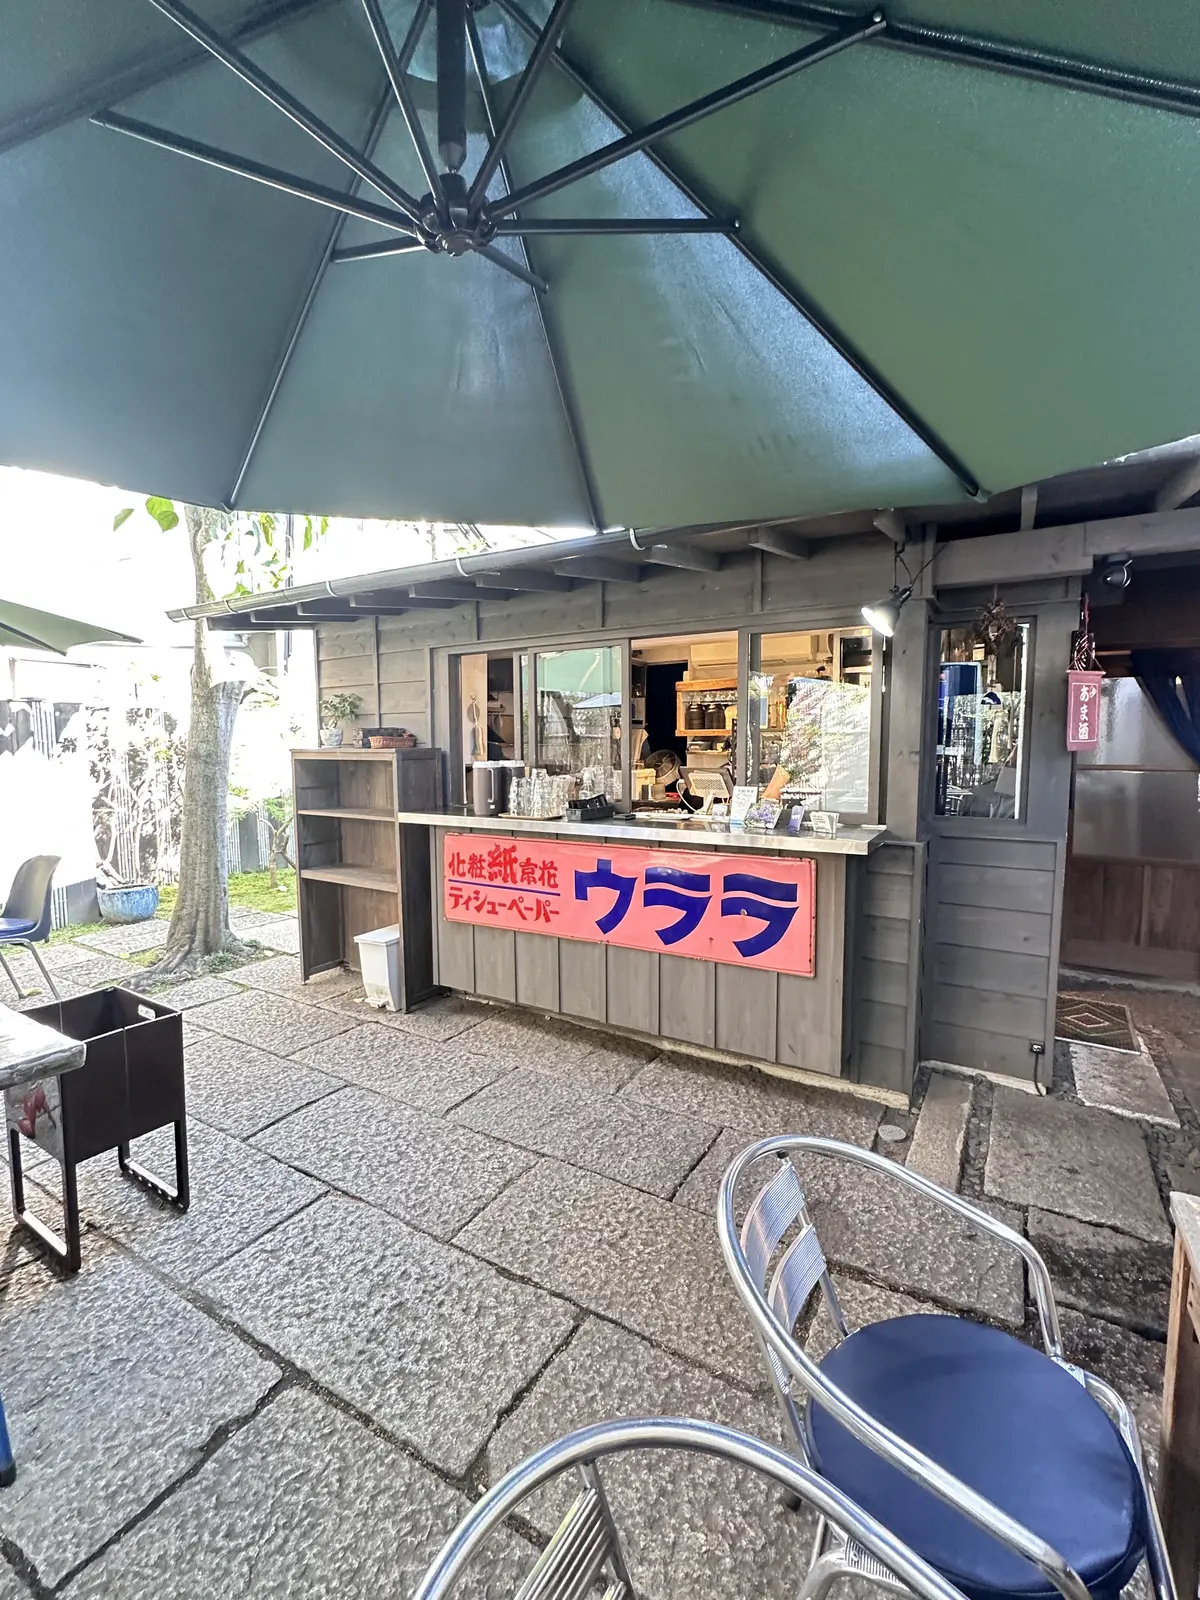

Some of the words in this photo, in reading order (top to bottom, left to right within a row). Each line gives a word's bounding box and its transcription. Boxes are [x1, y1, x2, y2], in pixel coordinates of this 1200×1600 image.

[1078, 685, 1089, 740] あま酒
[448, 886, 560, 923] ティシューペーパー
[574, 858, 800, 958] ウララ
